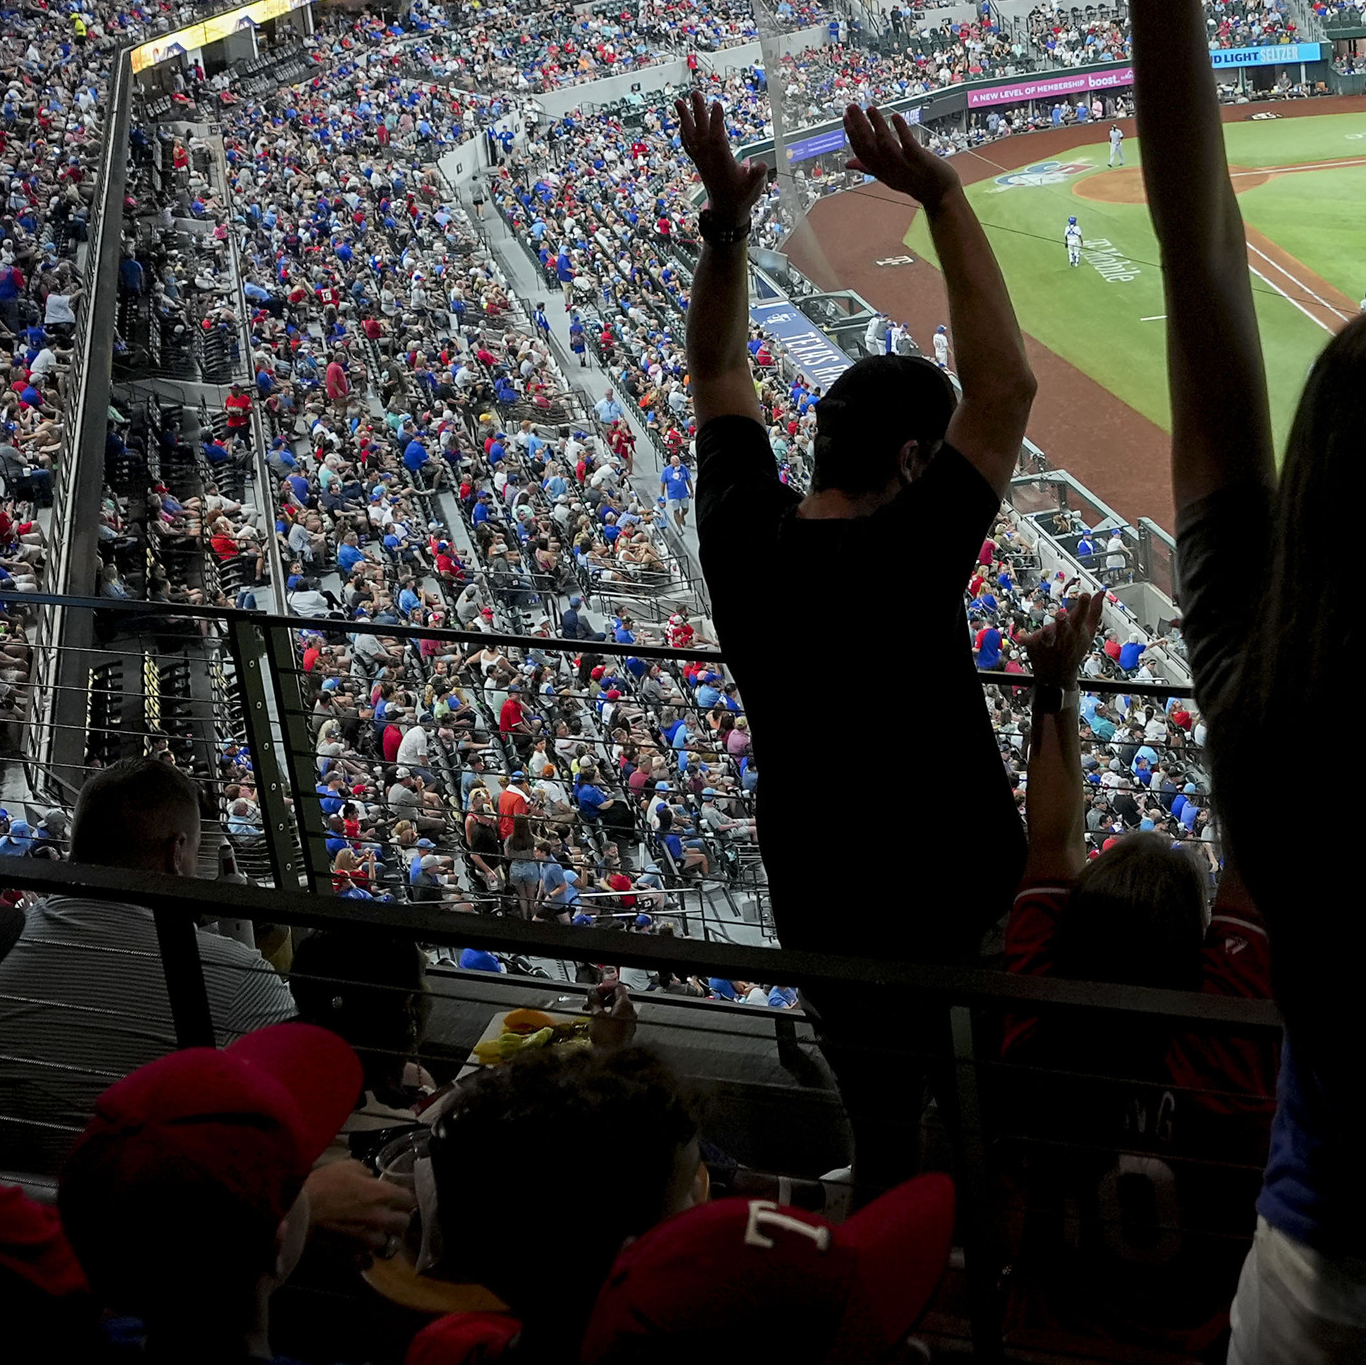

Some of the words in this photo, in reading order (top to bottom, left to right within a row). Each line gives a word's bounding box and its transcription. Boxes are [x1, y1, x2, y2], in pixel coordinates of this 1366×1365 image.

[1224, 51, 1259, 63] LIGHT
[1260, 46, 1299, 62] SELTZER
[979, 93, 998, 101] NEW
[1000, 90, 1023, 99] LEVEL
[1025, 87, 1036, 95] OF
[1037, 80, 1085, 94] MEMBERSHIP
[1079, 247, 1141, 283] Mobile
[781, 331, 840, 366] TEXAS
[744, 1199, 832, 1253] T
